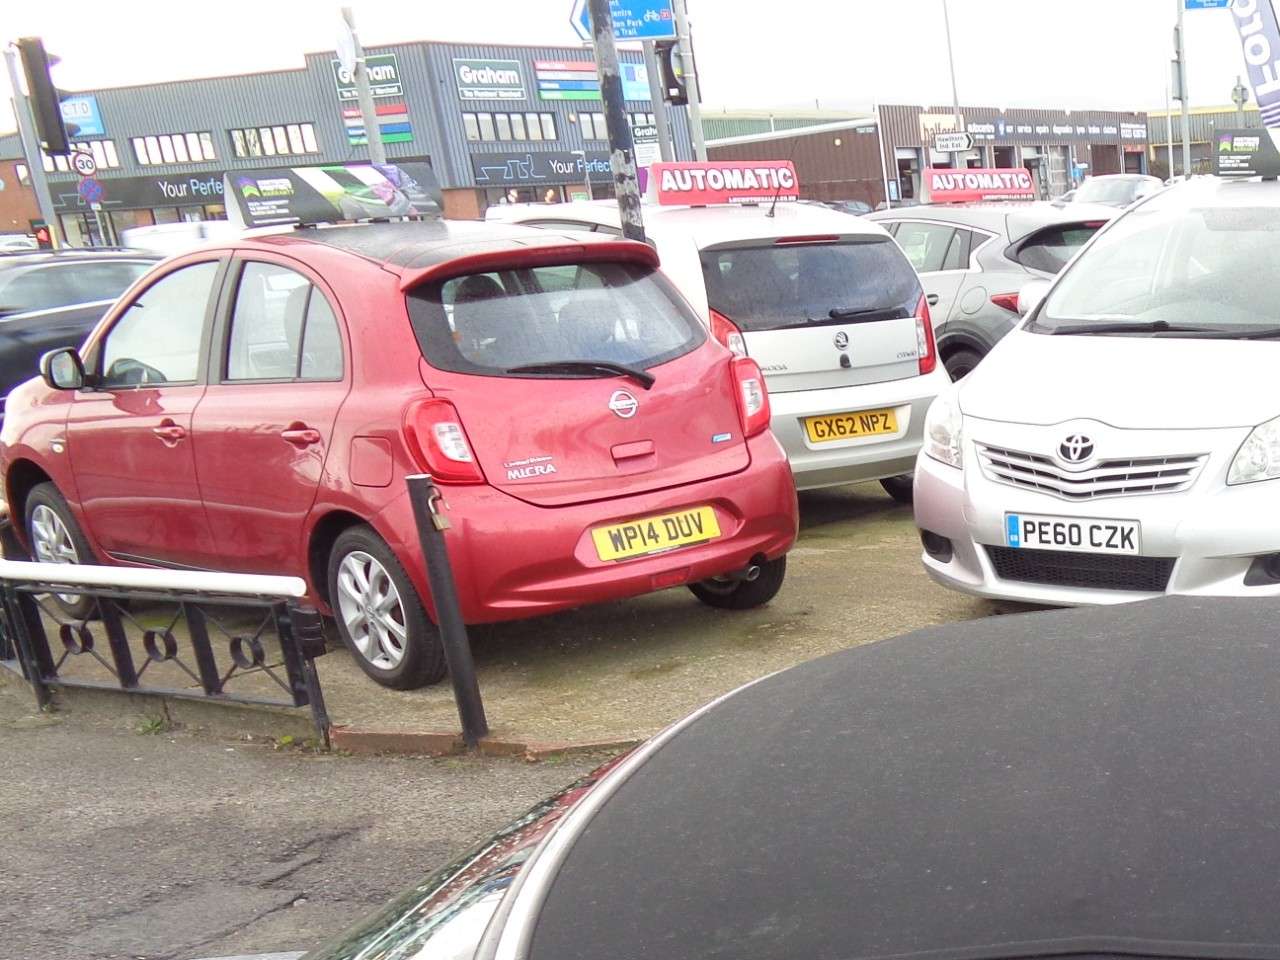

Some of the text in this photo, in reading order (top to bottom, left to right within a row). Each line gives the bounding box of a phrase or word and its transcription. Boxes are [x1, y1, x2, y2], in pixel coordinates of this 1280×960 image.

[460, 65, 520, 84] Graham
[78, 158, 94, 170] 30
[549, 159, 574, 174] Your
[158, 178, 224, 198] Your Perfe
[661, 167, 795, 192] AUTOMATIC
[932, 173, 1031, 190] AUTOMATIC
[814, 412, 891, 438] GX62 NPZ
[507, 463, 557, 480] MICRA
[608, 511, 704, 552] WP14 DUV
[1023, 520, 1135, 549] PE60 CZK
